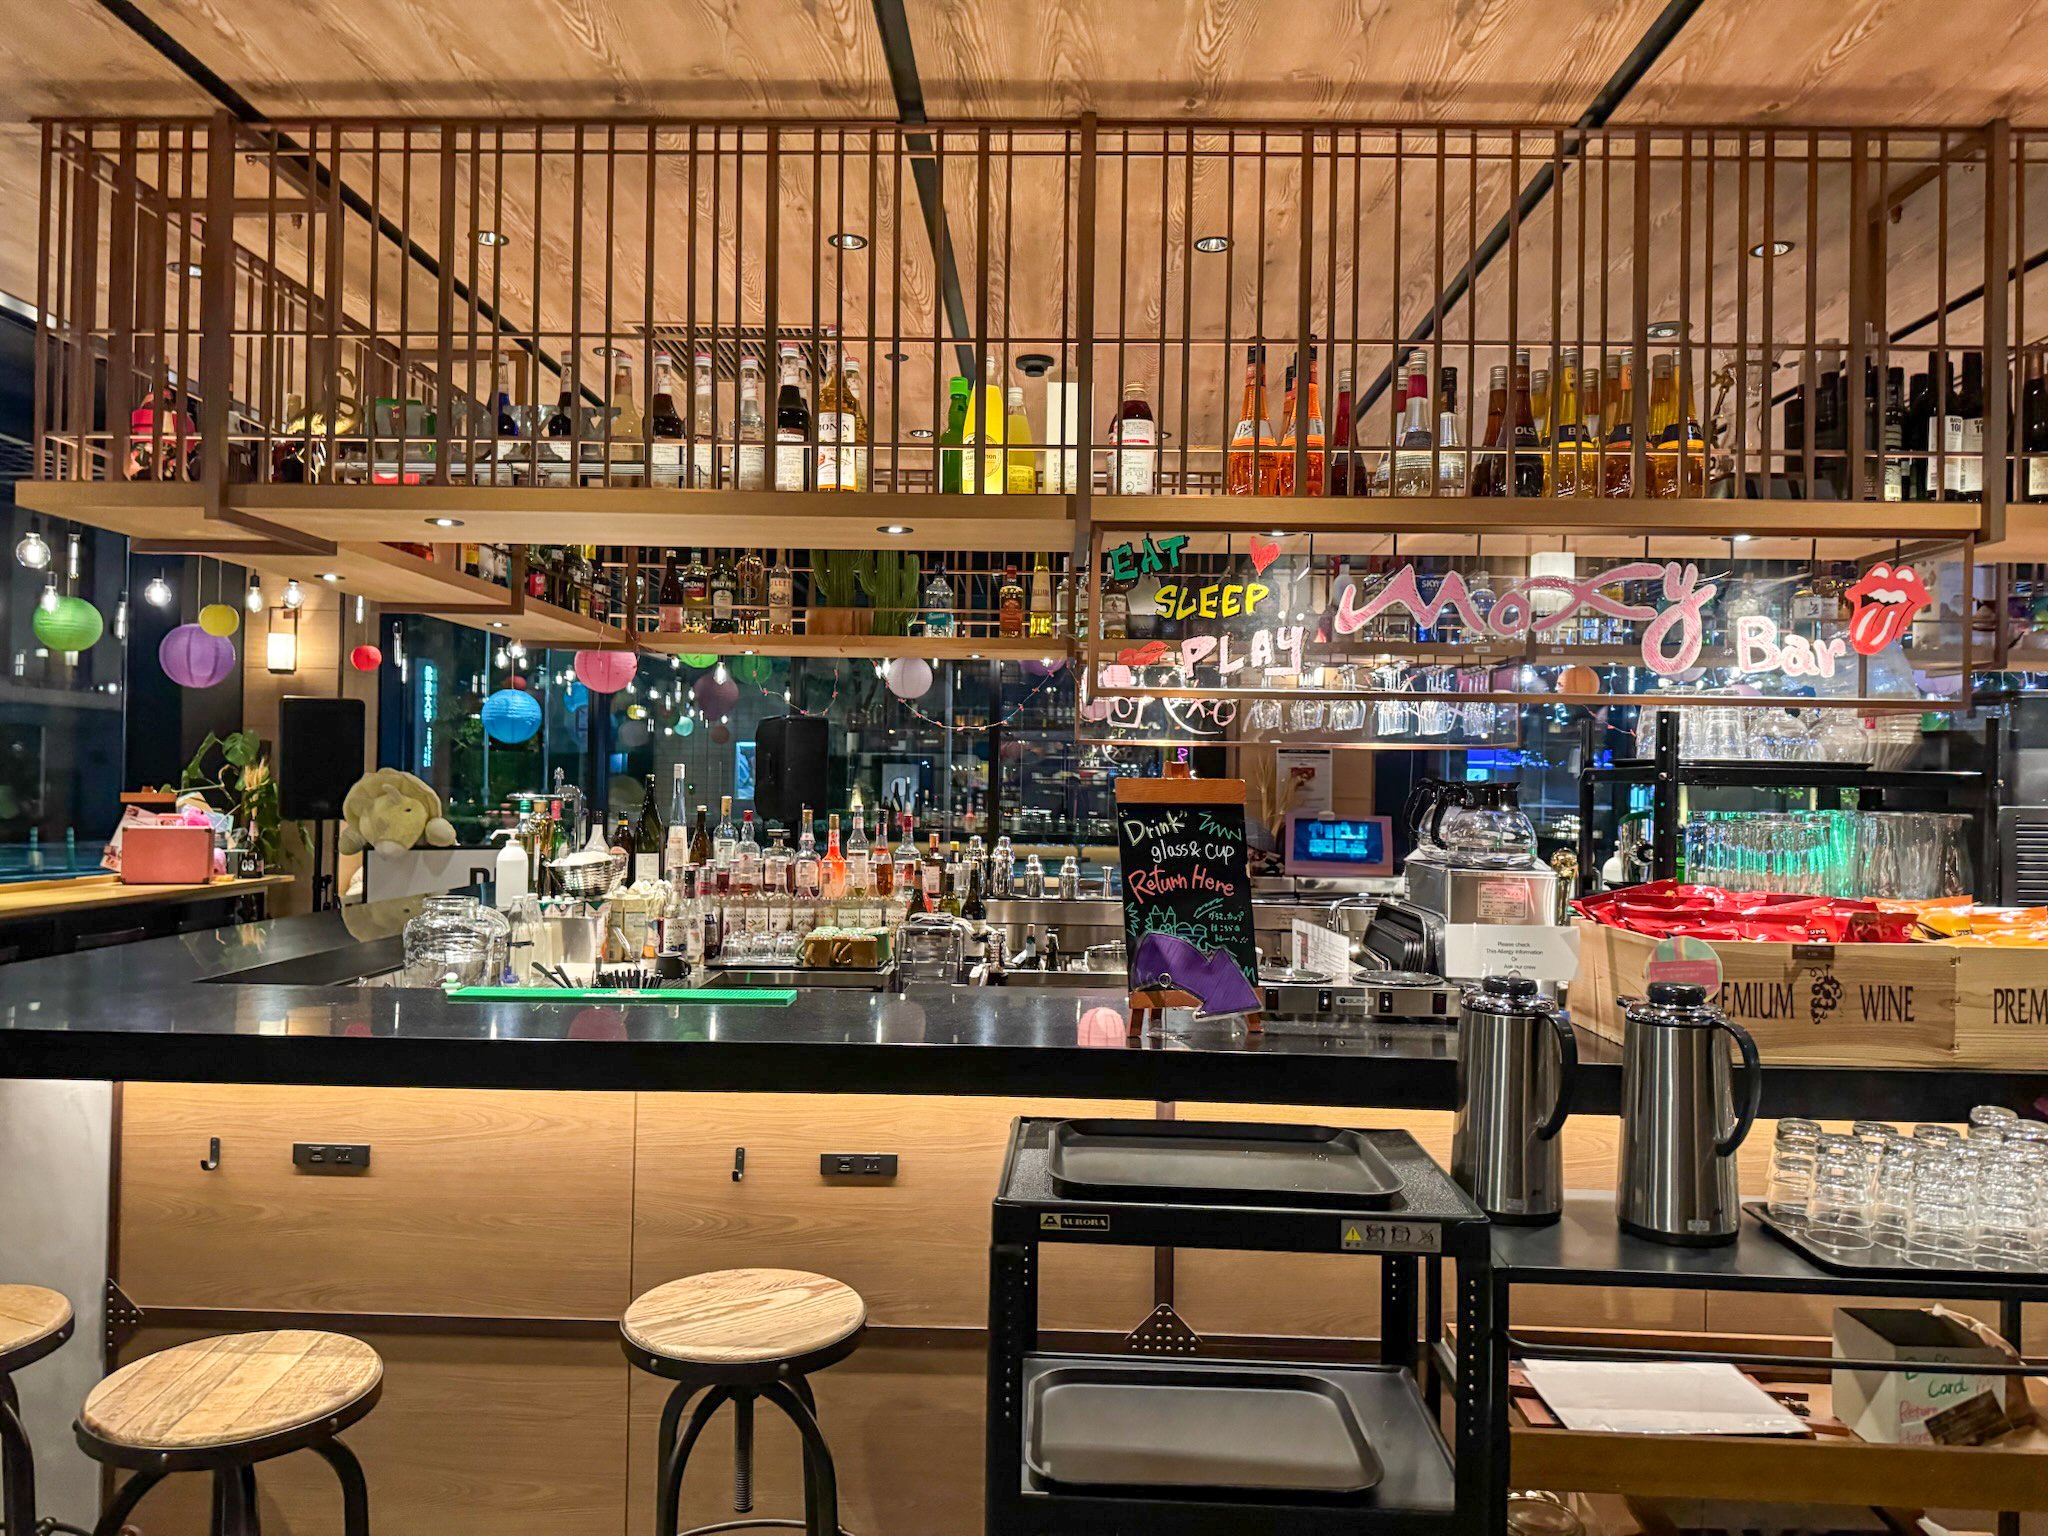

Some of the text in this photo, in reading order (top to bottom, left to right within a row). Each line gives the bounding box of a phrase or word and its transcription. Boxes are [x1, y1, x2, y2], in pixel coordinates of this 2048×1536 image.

[819, 423, 850, 432] ONN
[1515, 425, 1536, 436] OLS
[1110, 535, 1190, 581] EAT
[1154, 583, 1269, 620] SLEEP
[1180, 625, 1310, 680] PLAY
[1736, 615, 1847, 678] Bar
[1128, 864, 1235, 904] Return Here
[1712, 981, 1795, 1019] EMIUM
[1859, 984, 1915, 1023] WINE
[1062, 1218, 1107, 1226] AURORA
[1928, 1376, 1969, 1398] Card
